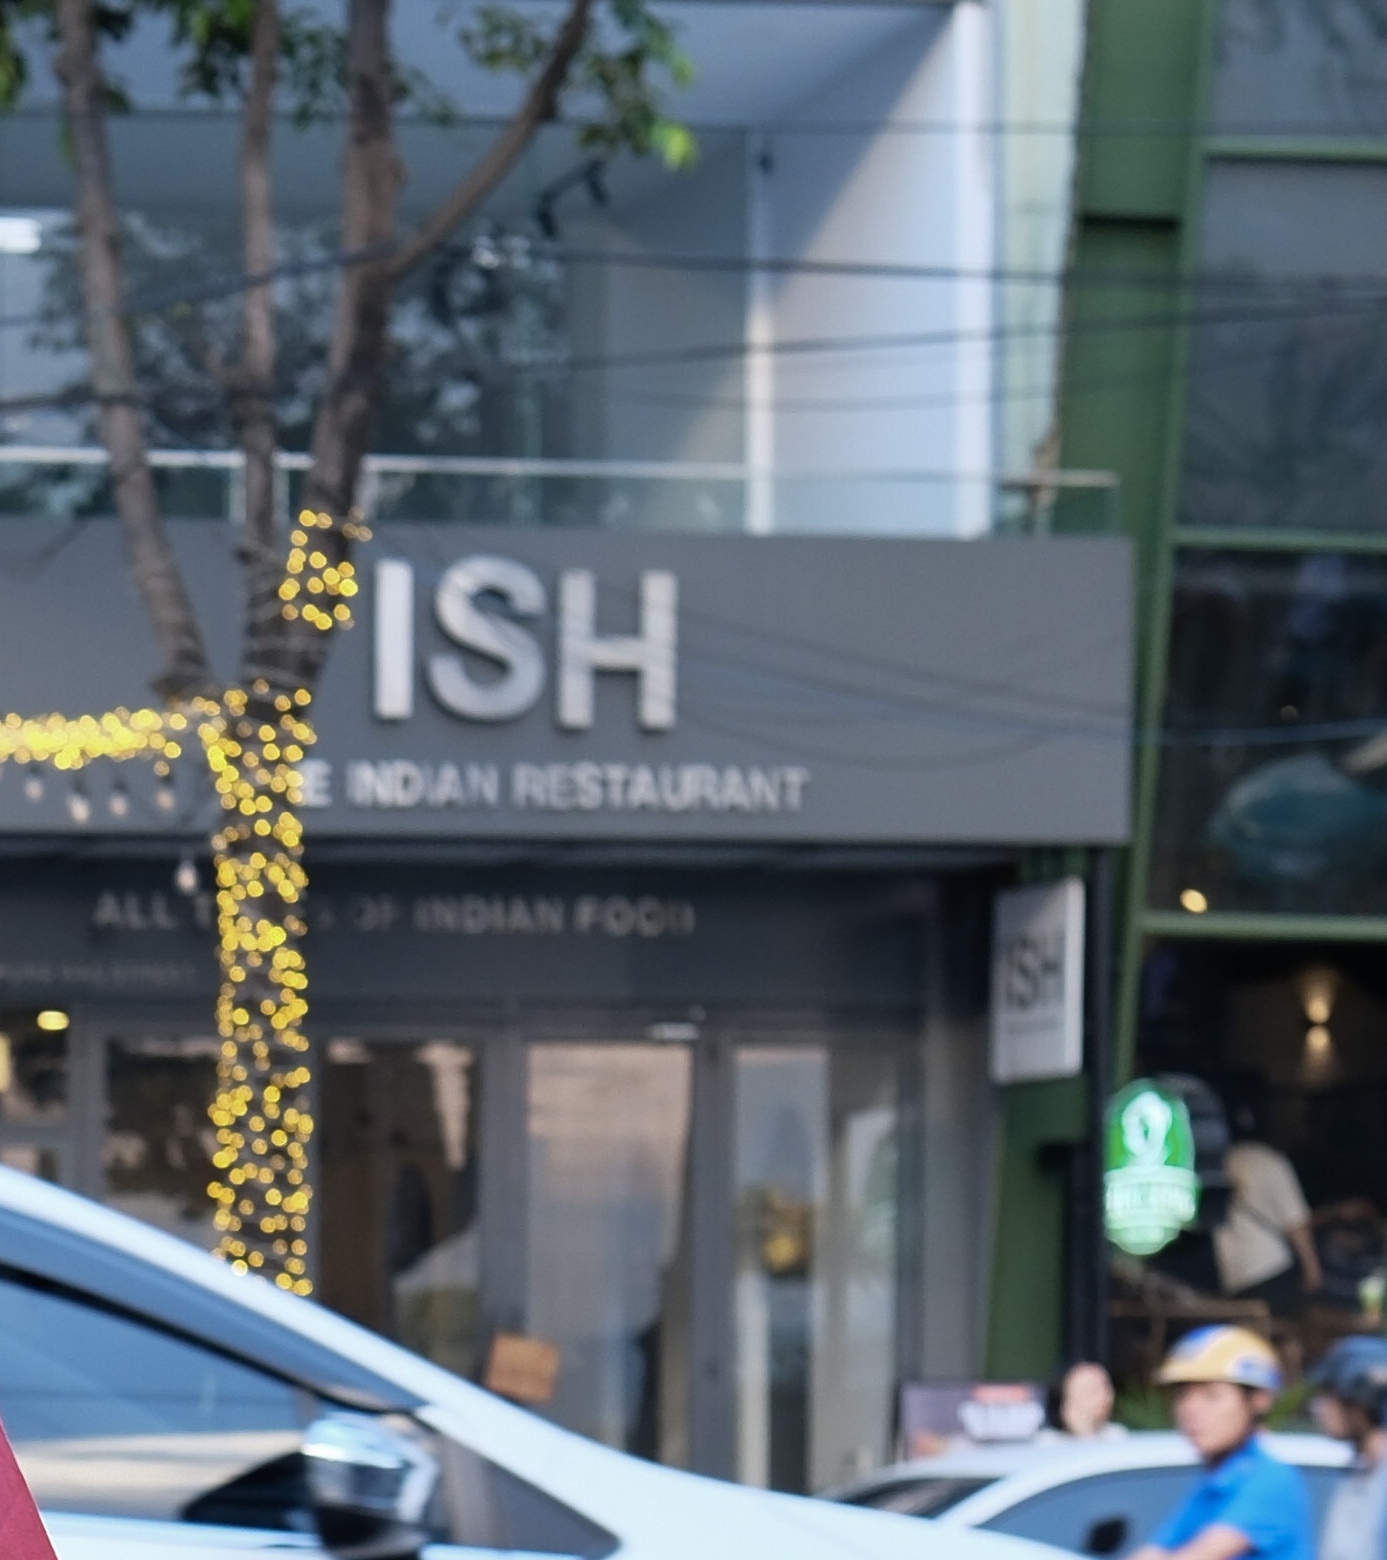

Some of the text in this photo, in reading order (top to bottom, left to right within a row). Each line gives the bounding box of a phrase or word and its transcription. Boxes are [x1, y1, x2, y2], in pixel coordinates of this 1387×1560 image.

[373, 554, 677, 730] ISH
[346, 759, 500, 808] INDIAN
[511, 762, 810, 814] RESTAURANT
